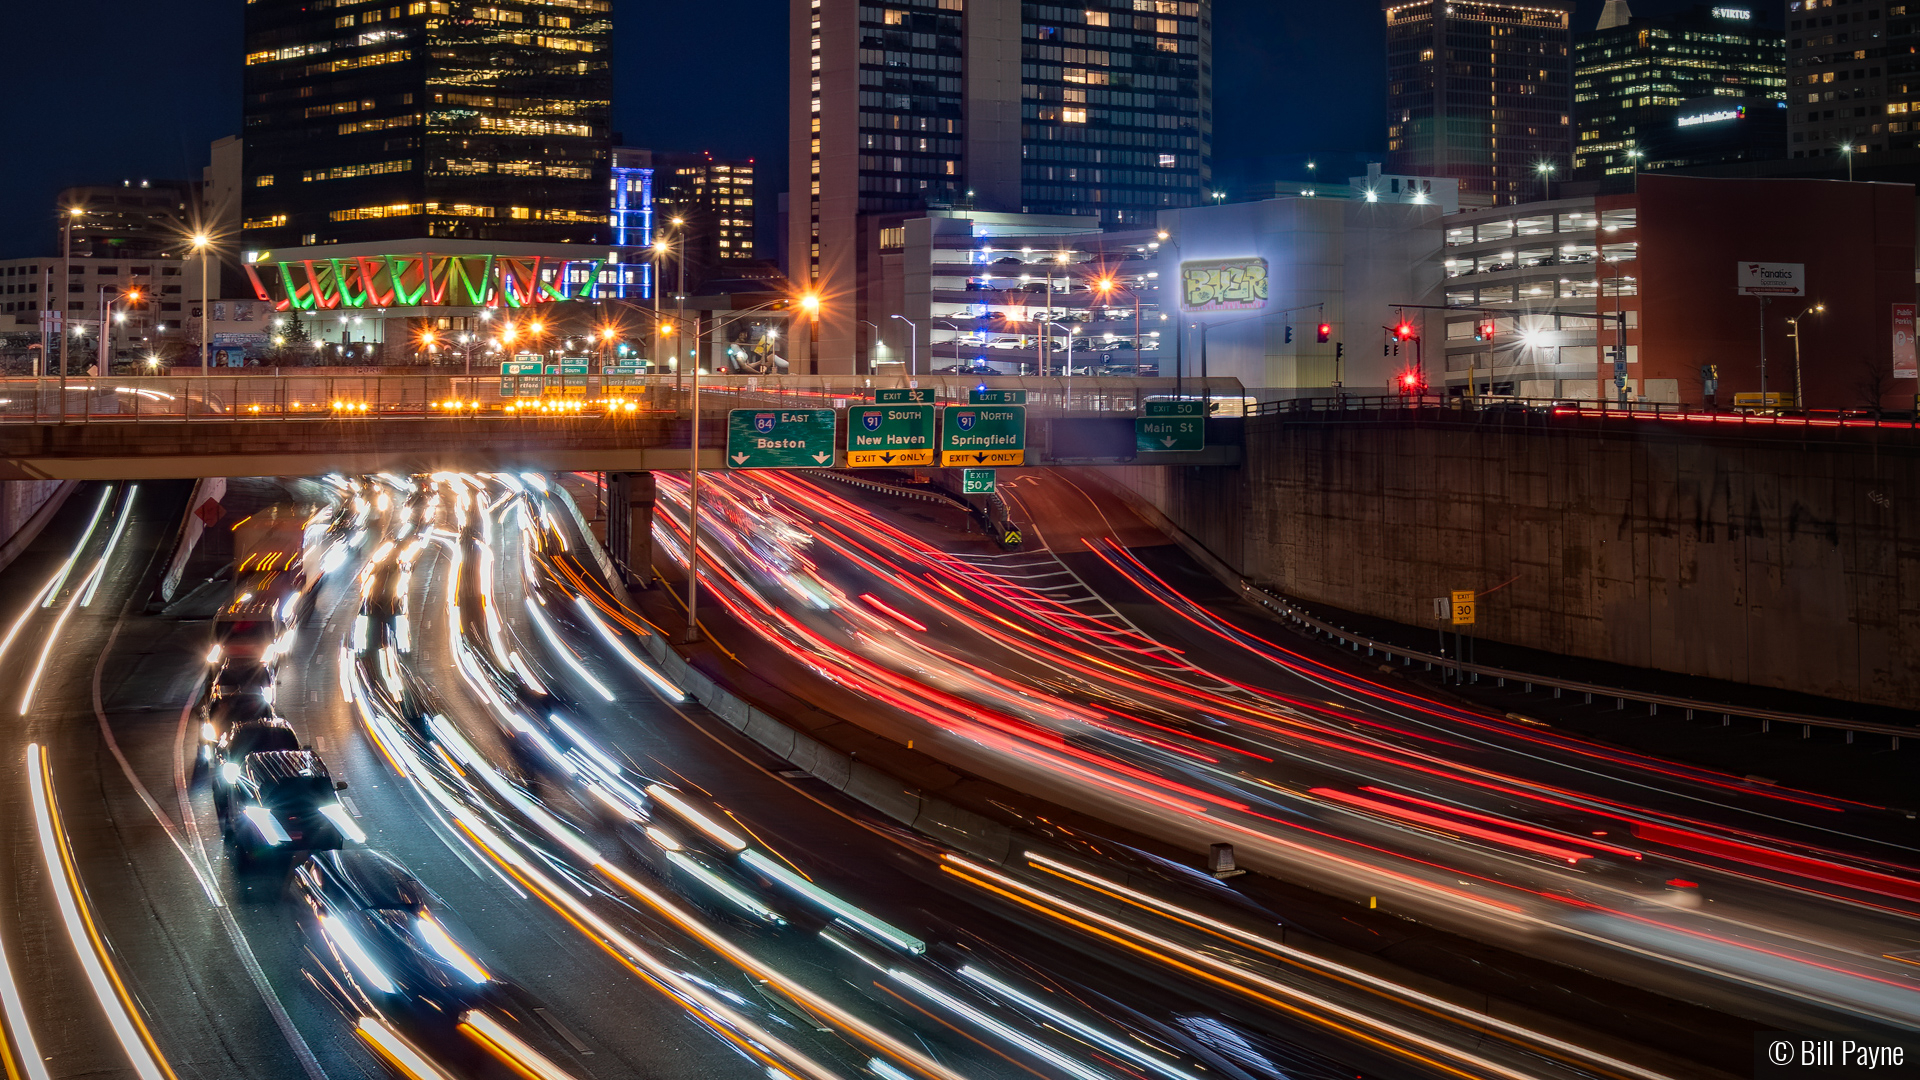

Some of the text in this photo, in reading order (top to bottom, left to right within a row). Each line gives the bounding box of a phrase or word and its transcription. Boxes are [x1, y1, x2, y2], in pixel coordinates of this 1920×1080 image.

[1720, 8, 1751, 20] VIRTUS
[1760, 267, 1793, 279] Fanatics
[908, 391, 924, 401] 52
[1003, 392, 1016, 402] 51
[1177, 405, 1193, 414] 50
[758, 419, 772, 429] 84
[781, 412, 809, 423] EAST
[867, 417, 878, 427] 91
[888, 410, 922, 420] SOUTH
[961, 417, 972, 427] 91
[980, 411, 1013, 420] NORTH
[1144, 422, 1194, 433] Main St
[757, 438, 806, 449] Boston
[856, 434, 926, 445] New Haven
[951, 434, 1017, 447] Springfield
[855, 453, 926, 463] EXIT ONLY
[949, 453, 1017, 462] EXIT ONLY
[967, 481, 983, 490] 50
[1457, 605, 1472, 615] 30
